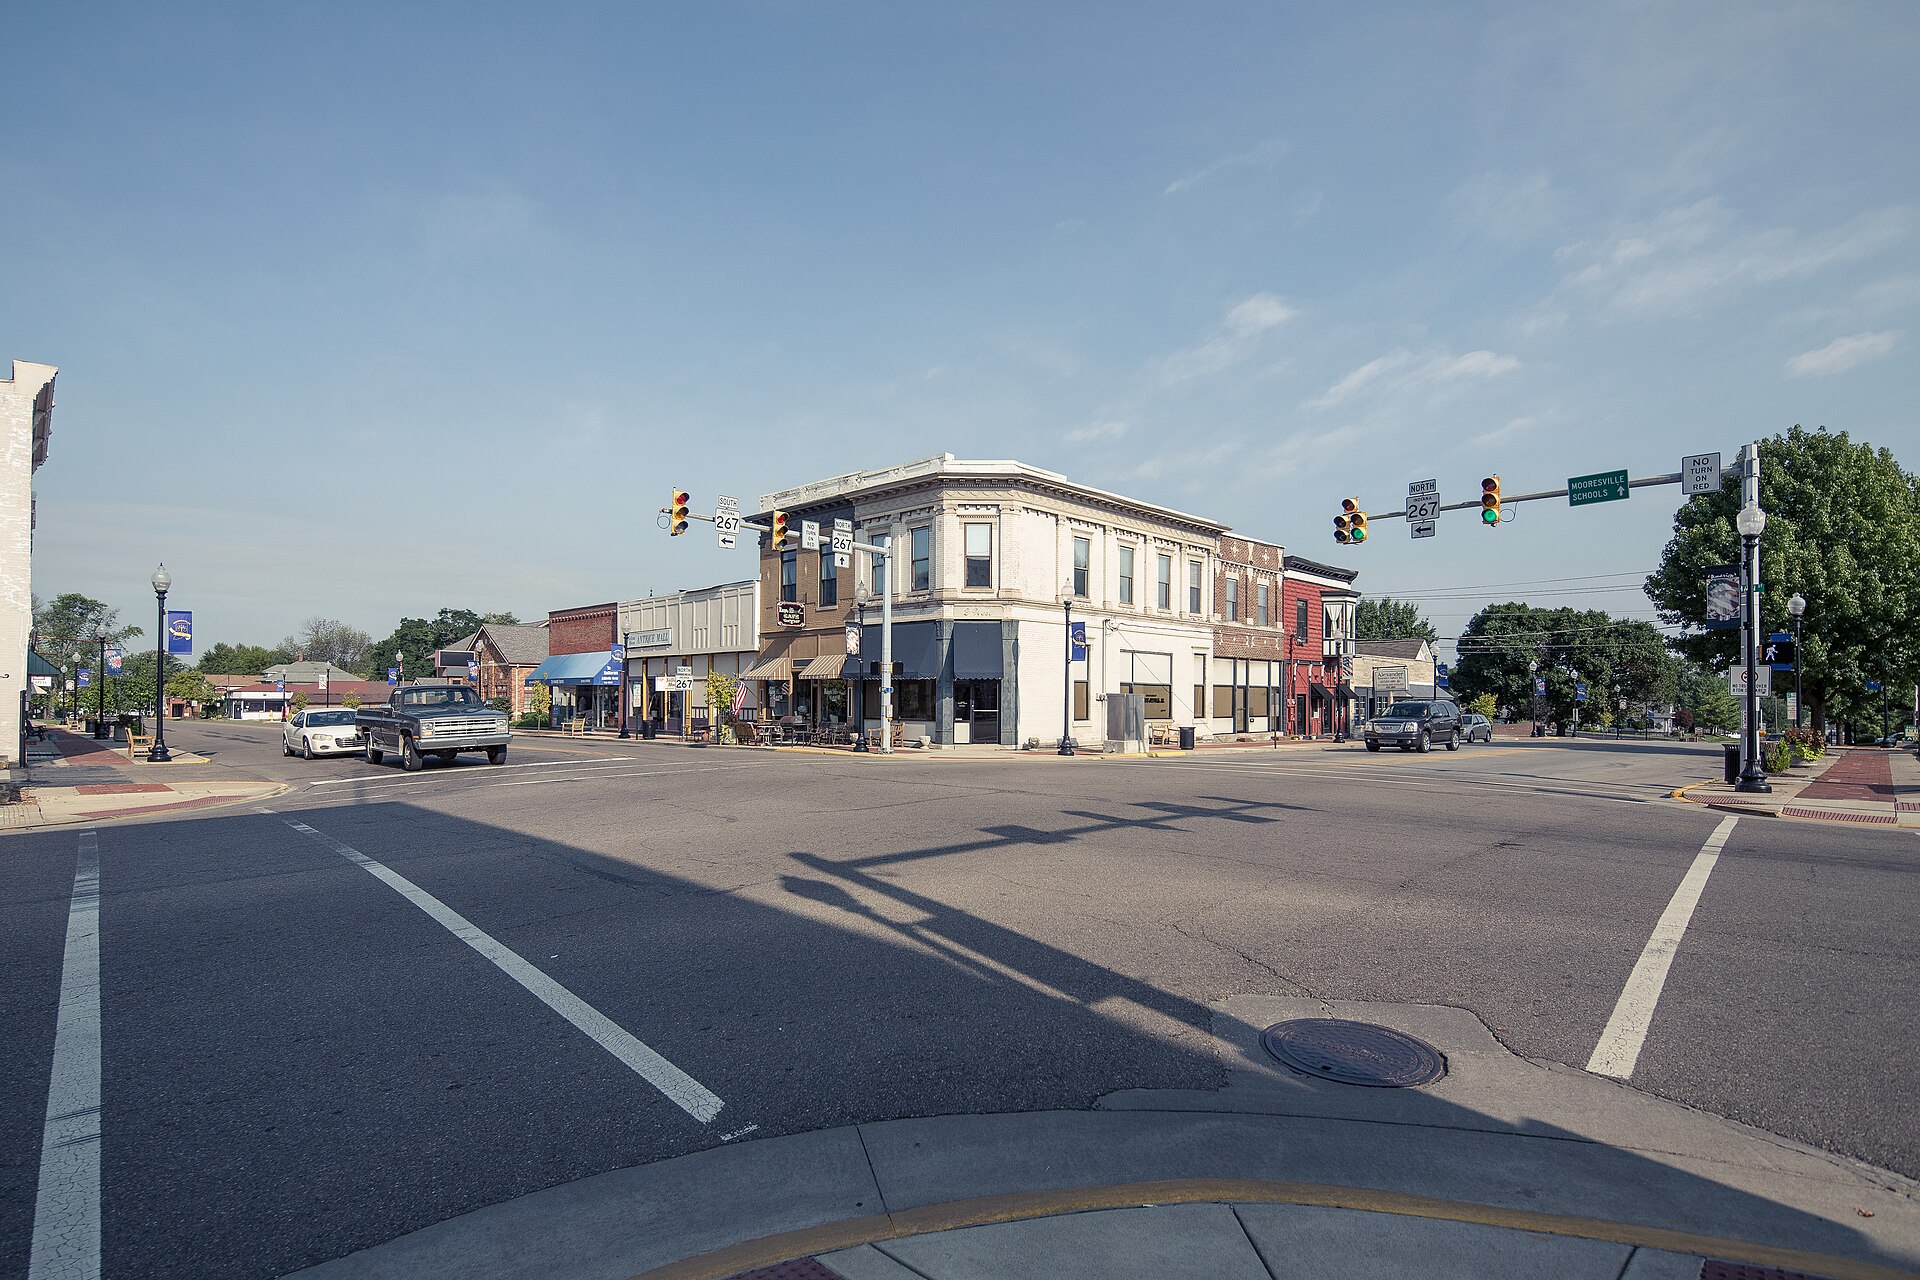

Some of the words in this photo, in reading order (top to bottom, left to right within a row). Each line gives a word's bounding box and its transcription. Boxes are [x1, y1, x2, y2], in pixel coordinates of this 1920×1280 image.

[1692, 457, 1710, 467] NO
[1690, 466, 1713, 475] TURN
[1410, 482, 1435, 493] NORTH
[1571, 475, 1625, 490] MOORESVILLE
[1692, 483, 1710, 491] RED
[1572, 488, 1608, 501] SCHOOLS
[719, 497, 737, 507] SOUTH
[1408, 501, 1438, 519] 267
[716, 516, 739, 531] 267
[806, 523, 815, 531] NO
[835, 521, 851, 529] NORTH
[833, 537, 852, 551] 267
[637, 633, 655, 644] ANTIQUE
[656, 632, 669, 642] MALL
[676, 679, 692, 689] 267
